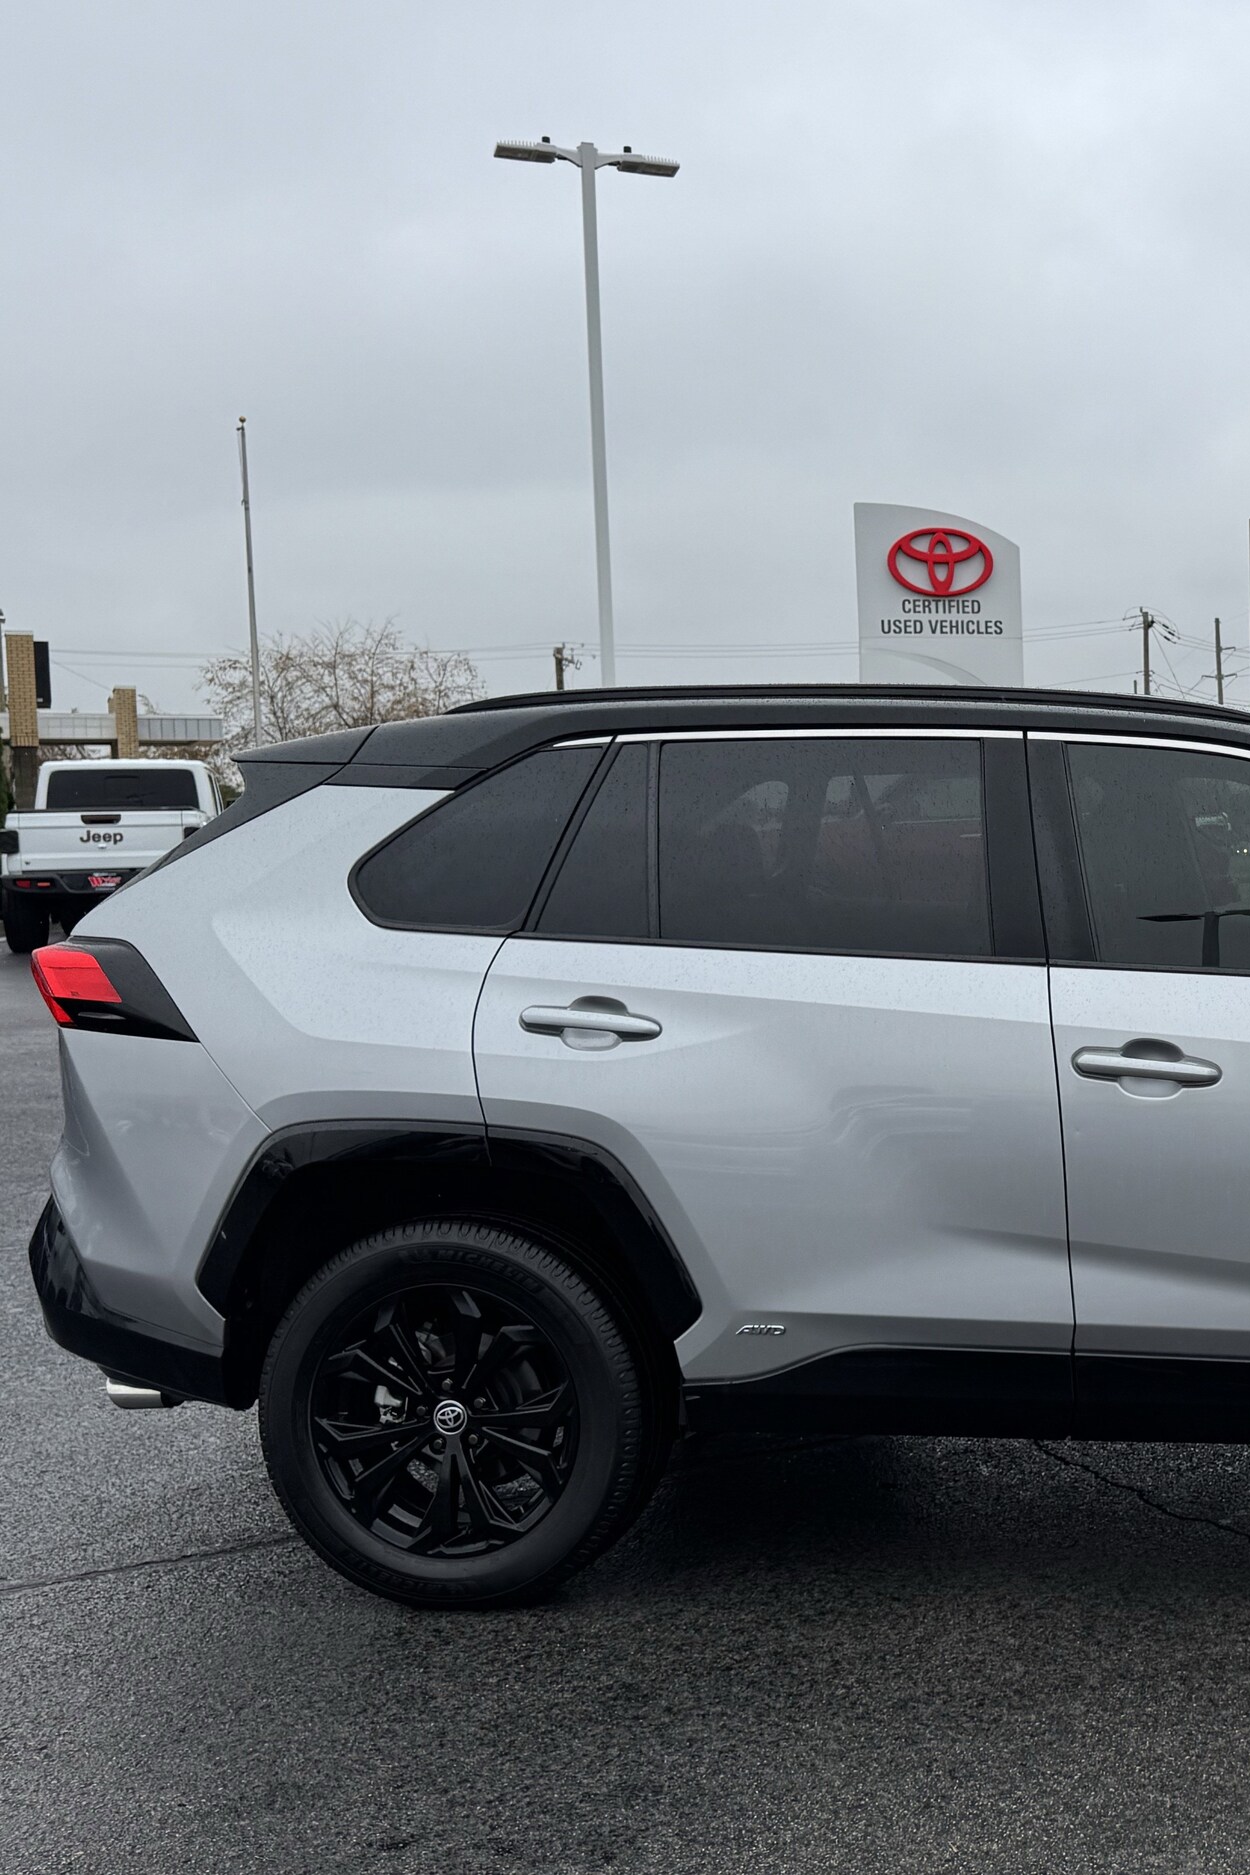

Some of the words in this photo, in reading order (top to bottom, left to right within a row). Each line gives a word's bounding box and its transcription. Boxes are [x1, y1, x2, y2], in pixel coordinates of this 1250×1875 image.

[902, 599, 981, 615] CERTIFIED
[880, 619, 924, 635] USED
[928, 619, 1004, 635] VEHICLES
[79, 829, 124, 845] Jeep
[735, 1324, 786, 1336] AWD
